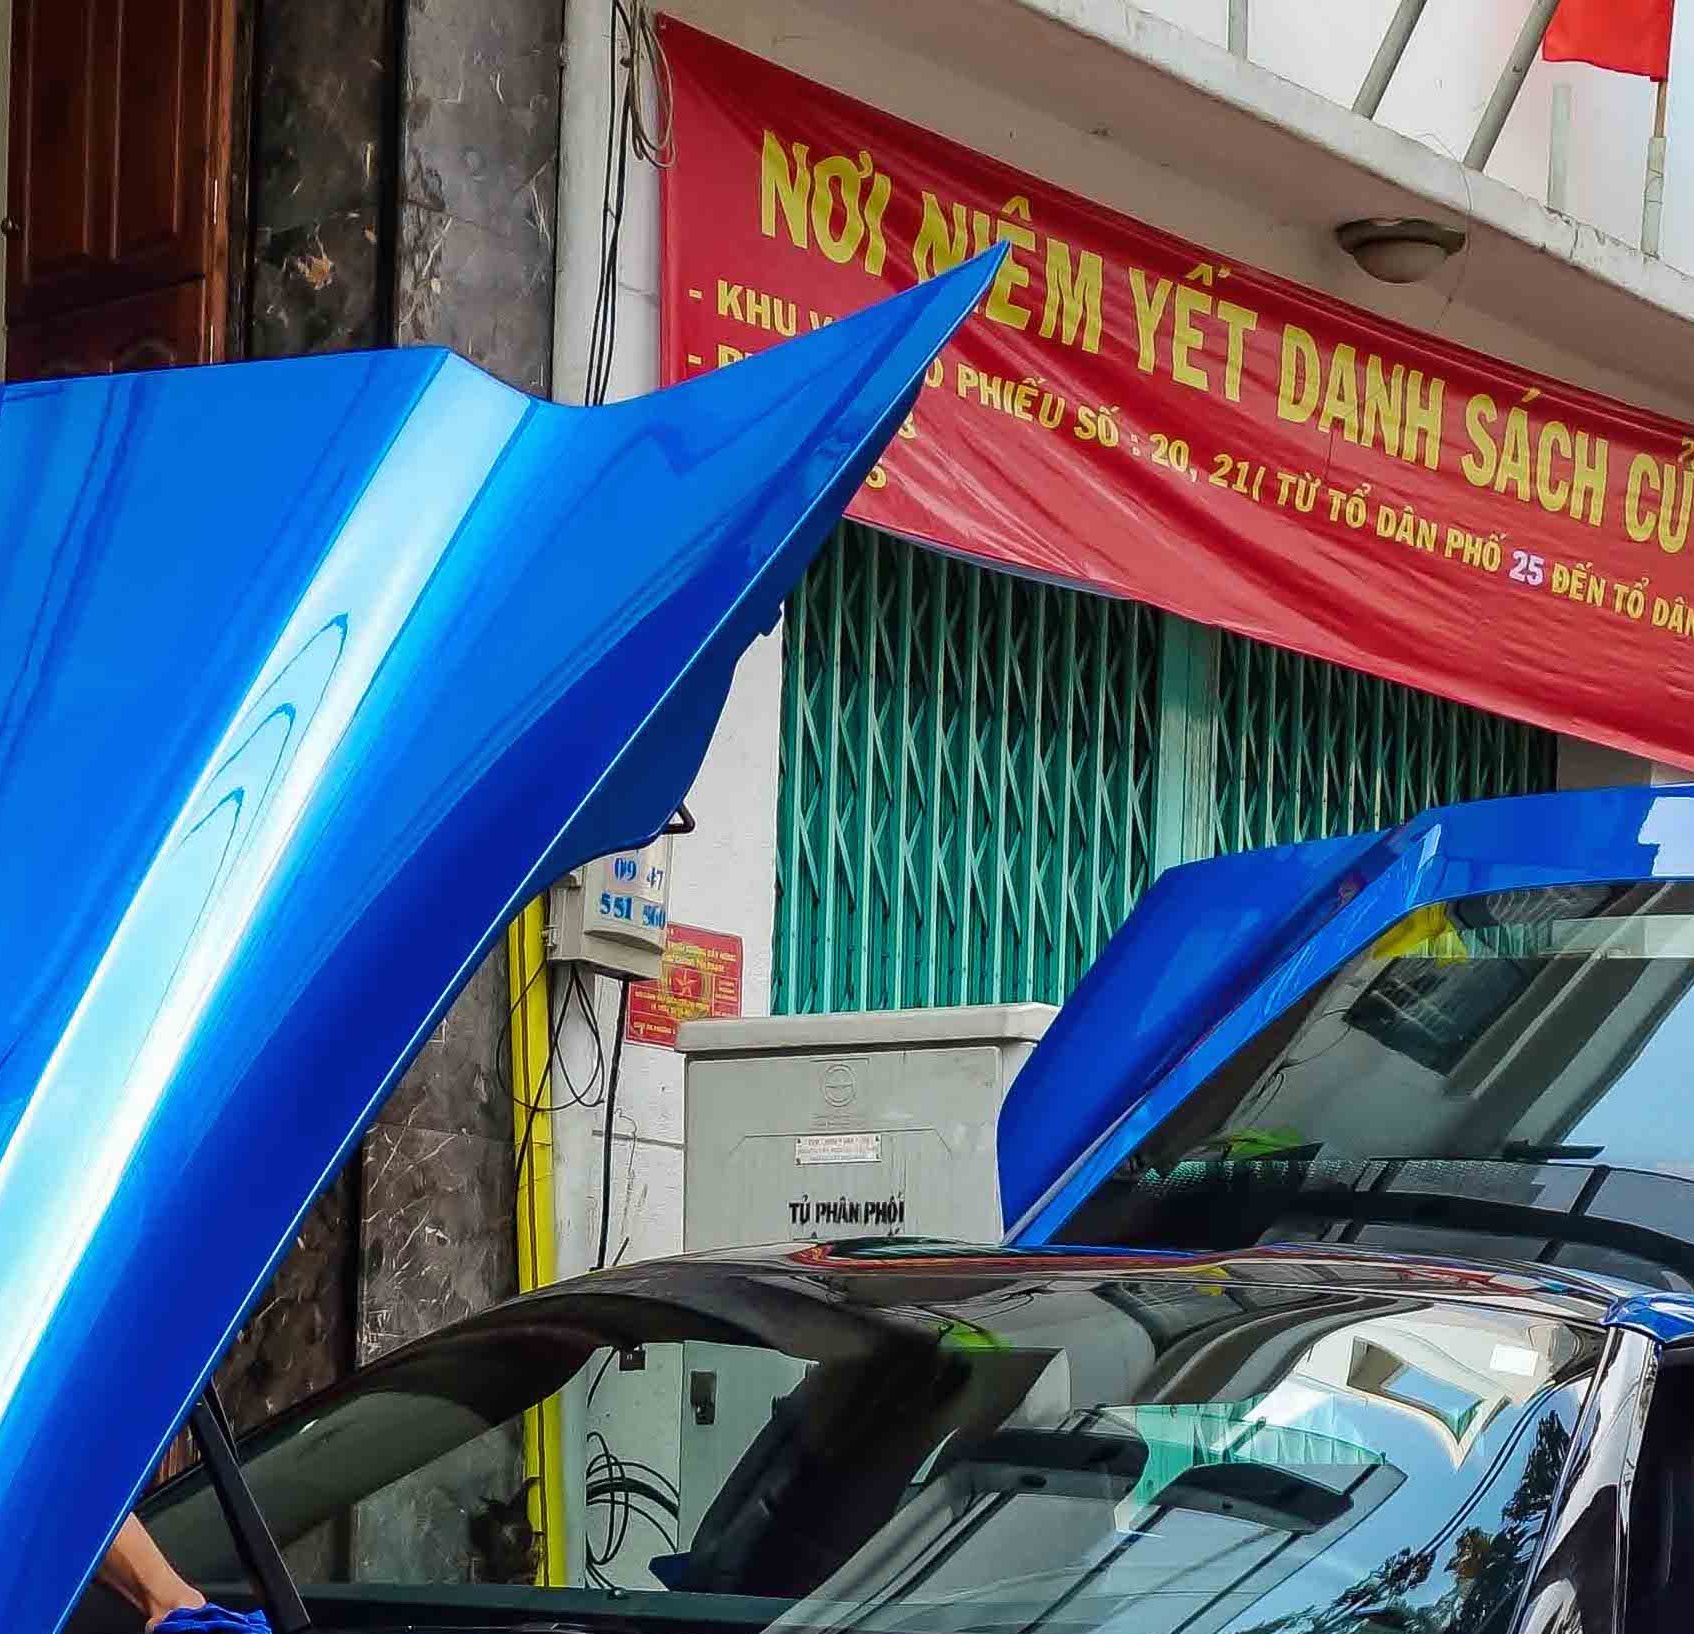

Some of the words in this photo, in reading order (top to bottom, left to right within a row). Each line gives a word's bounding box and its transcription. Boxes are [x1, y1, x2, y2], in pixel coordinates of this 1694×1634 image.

[718, 279, 796, 337] KHU
[761, 129, 892, 276] NƠI
[1276, 322, 1445, 471] DANH
[1461, 387, 1609, 527] SÁCH
[957, 362, 1067, 430] PHIẾU
[1074, 406, 1121, 447] SỐ
[1275, 471, 1322, 513] TỪ
[1328, 482, 1373, 531] TỔ
[1376, 503, 1437, 554] DÂN
[1444, 526, 1507, 573] PHỐ
[1508, 548, 1545, 587] 25
[1550, 561, 1607, 609] ĐẾN
[1613, 577, 1650, 620] TỔ
[600, 892, 633, 921] 551
[788, 1193, 811, 1225] TỦ
[815, 1195, 859, 1224] PHÂN
[863, 1191, 905, 1225] PHỐI
